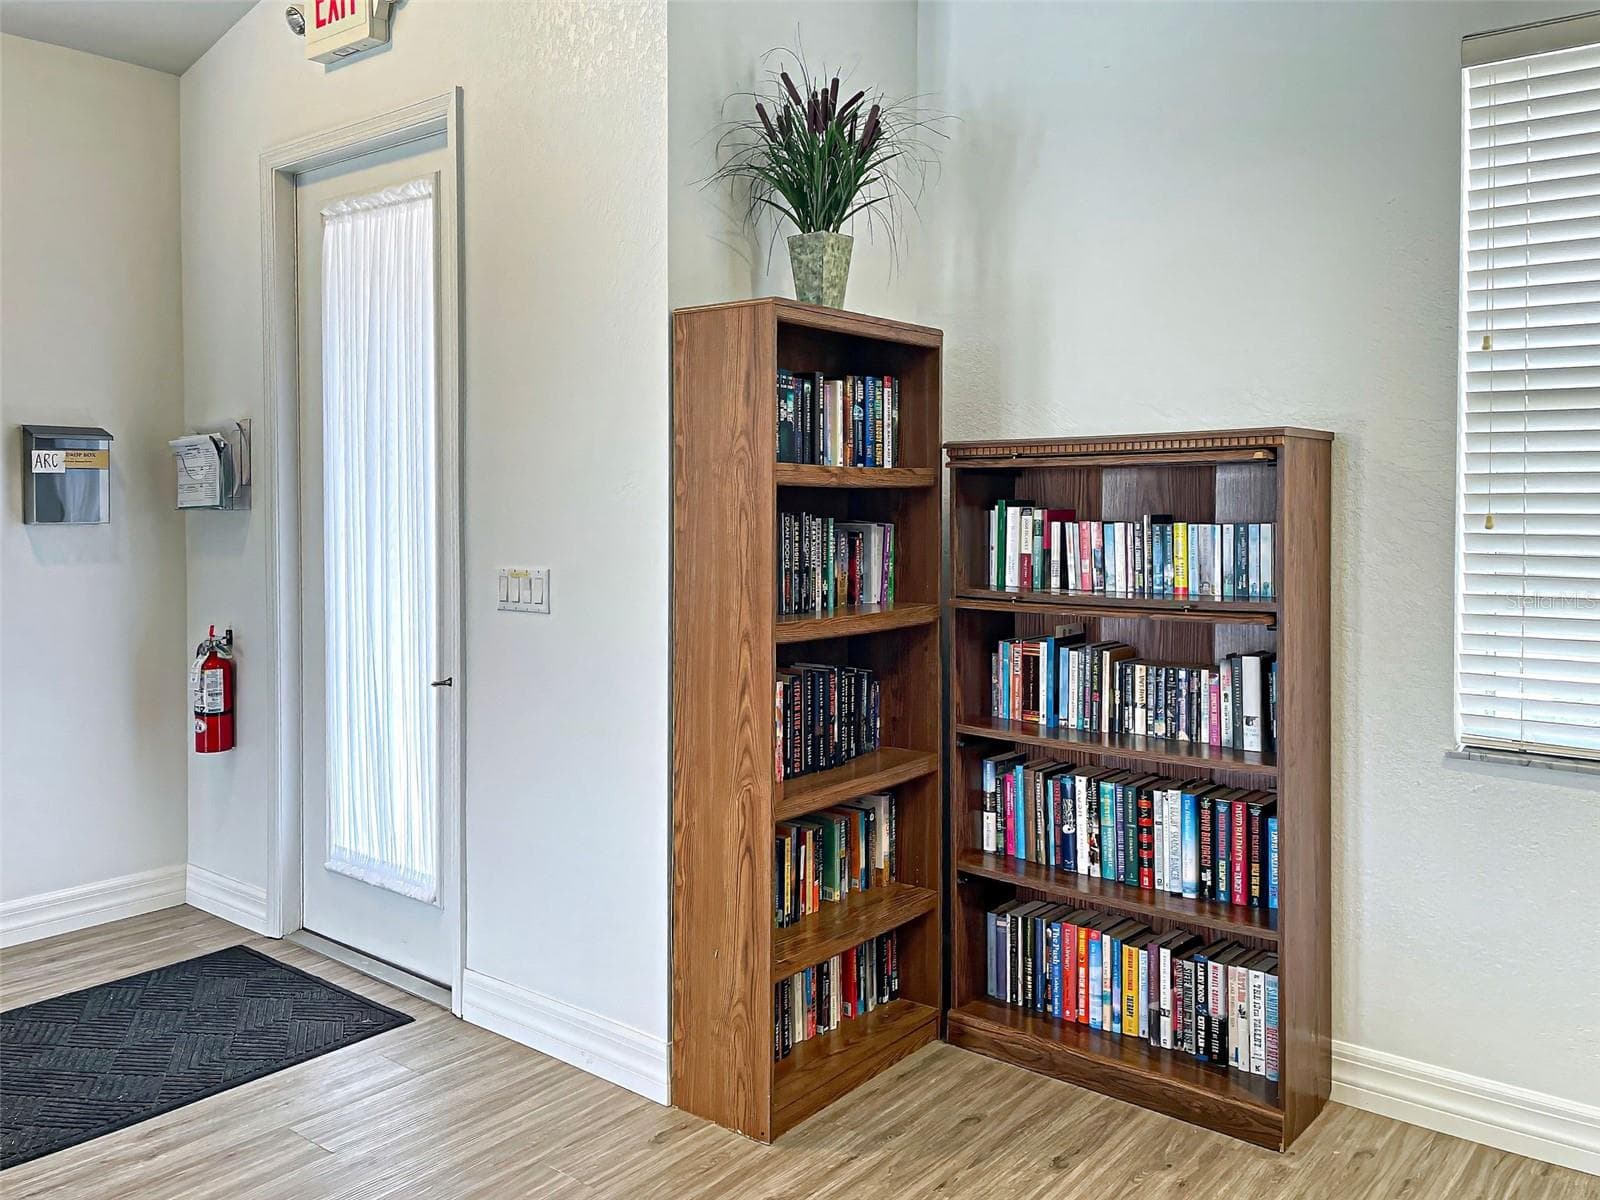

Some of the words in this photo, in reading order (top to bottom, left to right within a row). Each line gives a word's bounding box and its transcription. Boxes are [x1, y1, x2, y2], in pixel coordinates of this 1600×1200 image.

[34, 453, 59, 469] ARC
[1200, 809, 1211, 831] DAVID
[1218, 813, 1226, 831] DAVID
[1201, 832, 1212, 866] BALDACCI
[1218, 832, 1226, 858] BALDACCI
[1235, 826, 1243, 861] BALDACCI
[1234, 872, 1242, 893] TARGET
[1052, 928, 1060, 942] The
[1052, 944, 1060, 965] Push
[1184, 968, 1192, 986] STEVE
[1197, 963, 1205, 984] LARRY
[1197, 984, 1205, 1003] BOND
[1253, 984, 1261, 999] THE
[1126, 995, 1134, 1018] THERAPY
[1266, 988, 1278, 1025] SANDFORD
[1198, 1016, 1206, 1030] EXIT
[1211, 1018, 1219, 1034] STATE
[1253, 1018, 1262, 1047] VALLEY
[1198, 1031, 1206, 1048] PLAN
[1211, 1040, 1219, 1053] FEAR
